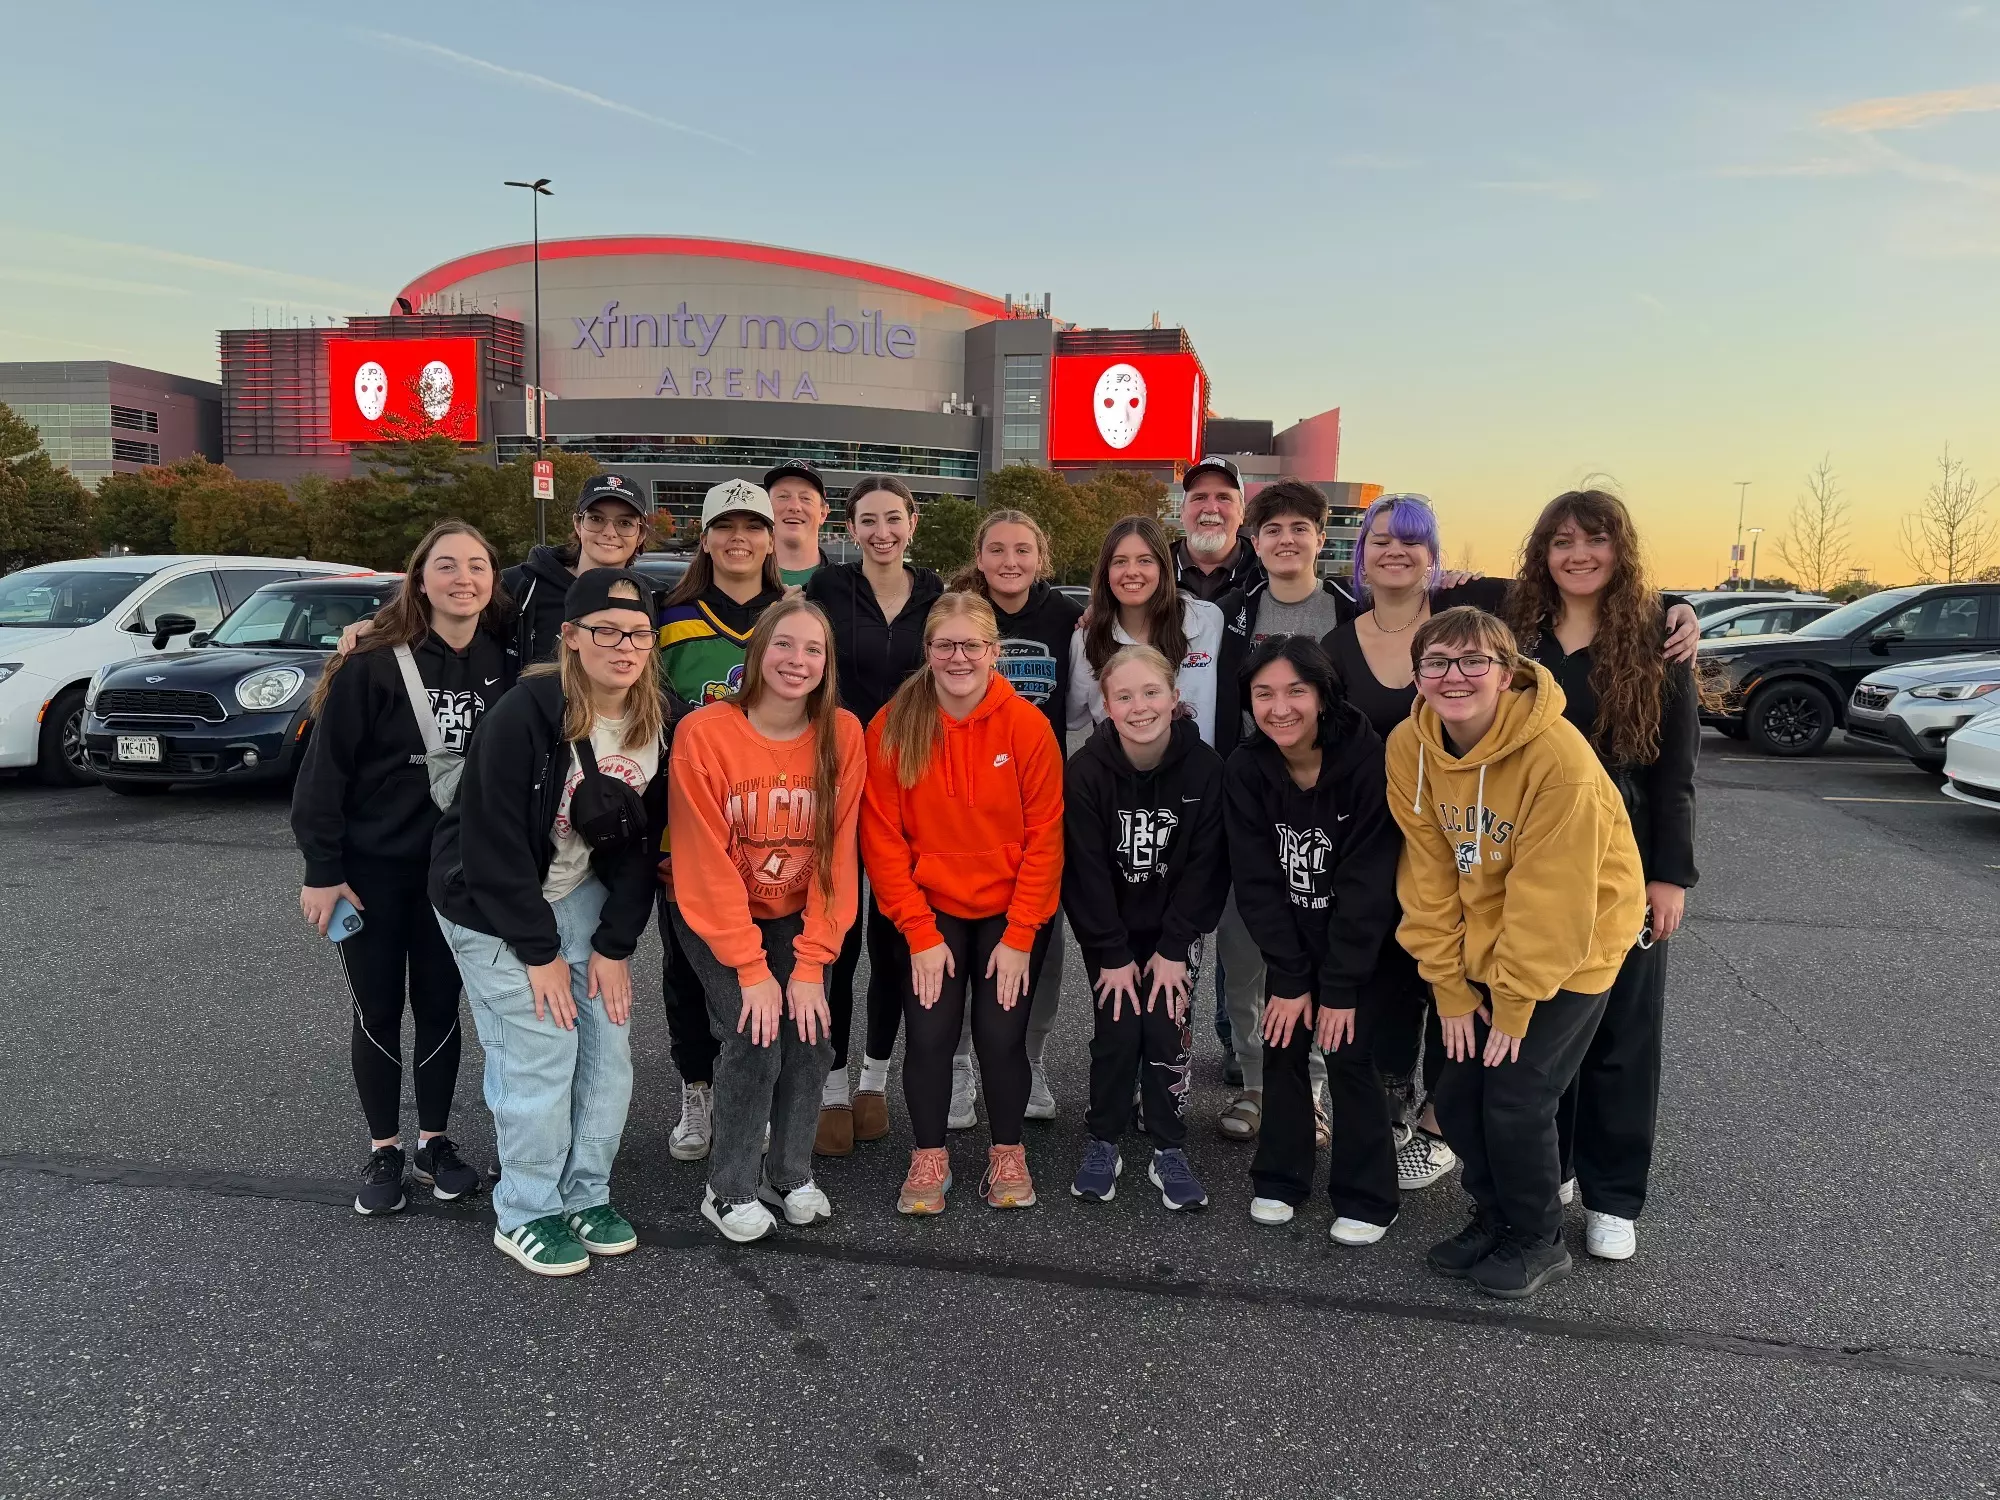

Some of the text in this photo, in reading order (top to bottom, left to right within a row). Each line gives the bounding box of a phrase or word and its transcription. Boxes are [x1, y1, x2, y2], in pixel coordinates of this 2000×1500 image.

[571, 301, 917, 359] xfinity mobile
[655, 367, 819, 400] ARENA
[537, 463, 550, 474] H1
[1023, 663, 1052, 677] GIRLS
[1023, 682, 1045, 692] 2023
[995, 753, 1008, 763] NIKE
[1439, 803, 1514, 844] LCONS
